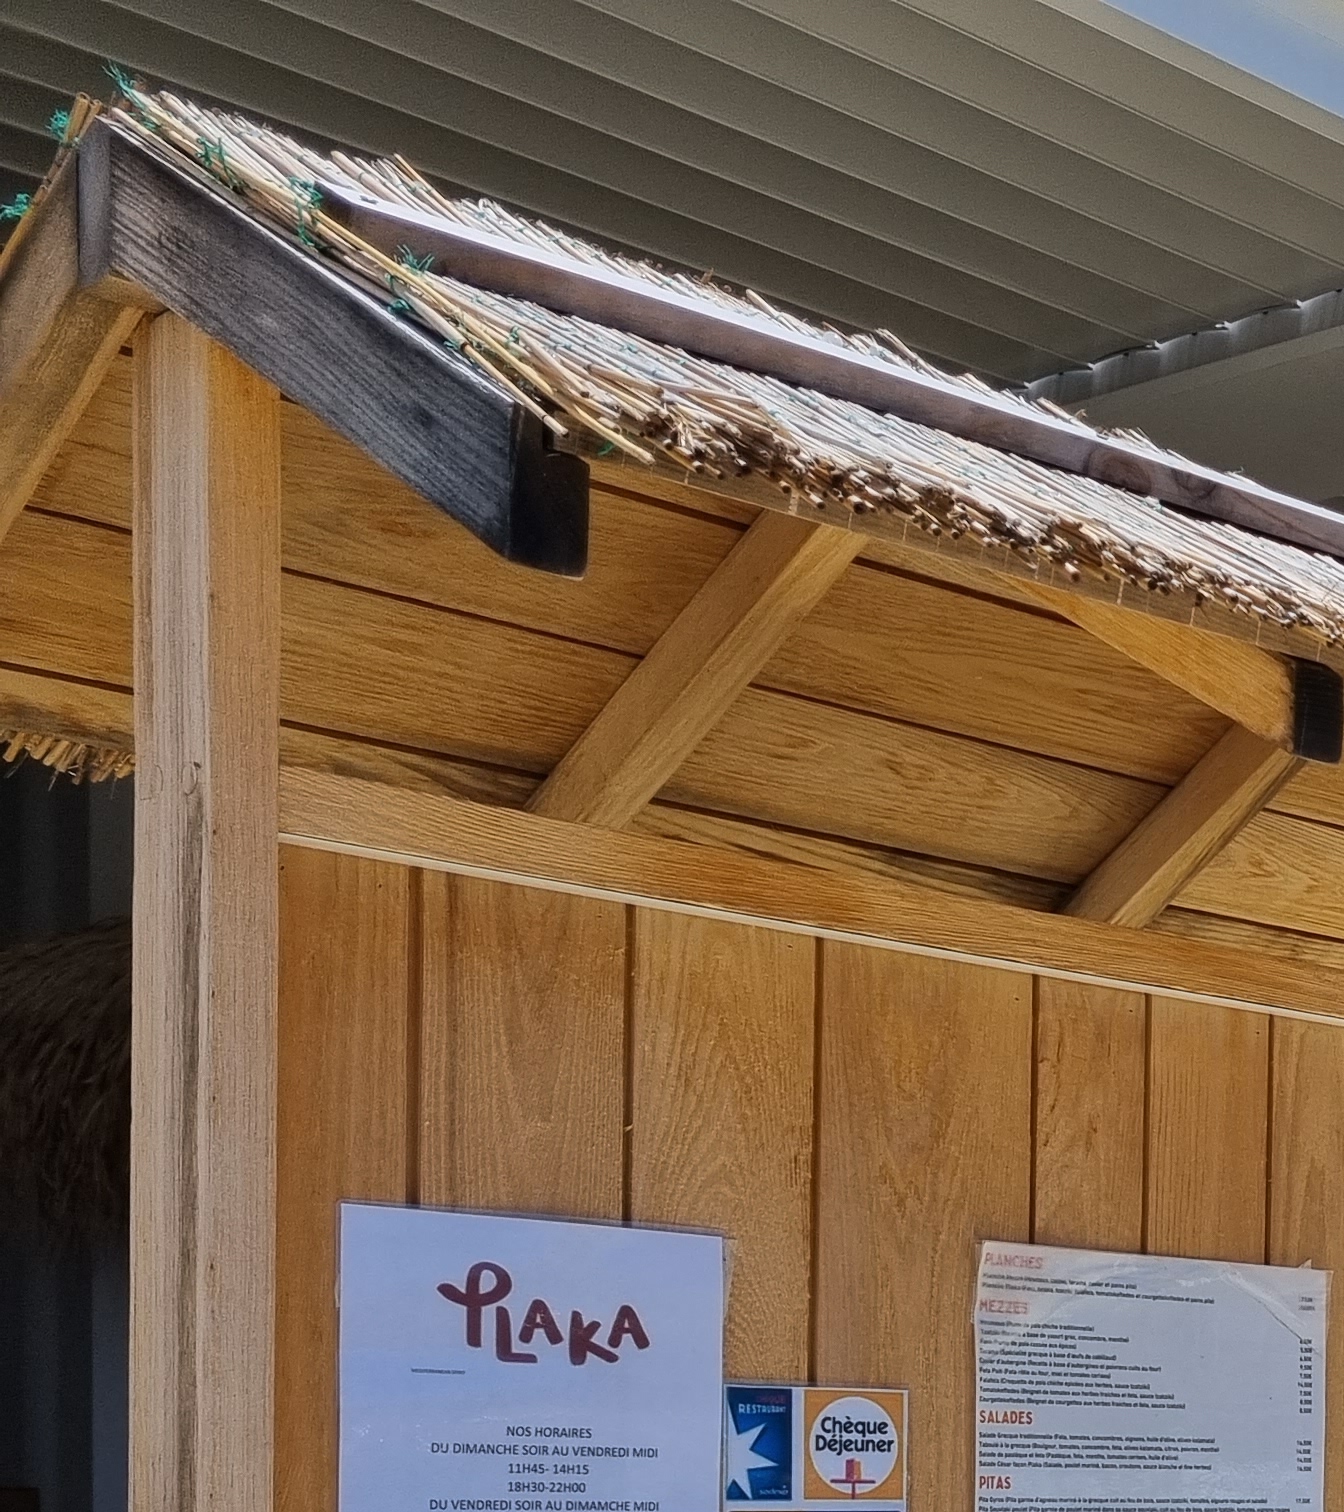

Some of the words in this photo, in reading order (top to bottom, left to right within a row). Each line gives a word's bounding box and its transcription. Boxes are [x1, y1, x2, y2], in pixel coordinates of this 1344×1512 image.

[984, 1252, 1043, 1270] PLANCHES
[436, 1261, 651, 1366] PLAKA
[979, 1299, 1029, 1314] MEZZES
[820, 1416, 889, 1435] Chèque
[979, 1410, 1033, 1426] SALADES
[506, 1425, 531, 1437] NOS
[534, 1426, 592, 1438] HORAIRES
[430, 1441, 449, 1453] DU
[452, 1442, 518, 1455] DIMANCHE
[520, 1444, 549, 1455] SOIR
[551, 1445, 569, 1456] AU
[571, 1445, 629, 1457] VENDREDI
[632, 1447, 658, 1458] MIDI
[815, 1434, 895, 1456] Déjeuner
[552, 1463, 589, 1475] 14H15
[507, 1481, 586, 1493] 18H30-22H00
[979, 1475, 1012, 1491] PITAS
[429, 1498, 448, 1510] DU
[450, 1499, 511, 1510] VENDREDI
[514, 1499, 542, 1510] SOIR
[544, 1499, 562, 1511] AU
[633, 1501, 659, 1511] MIDI
